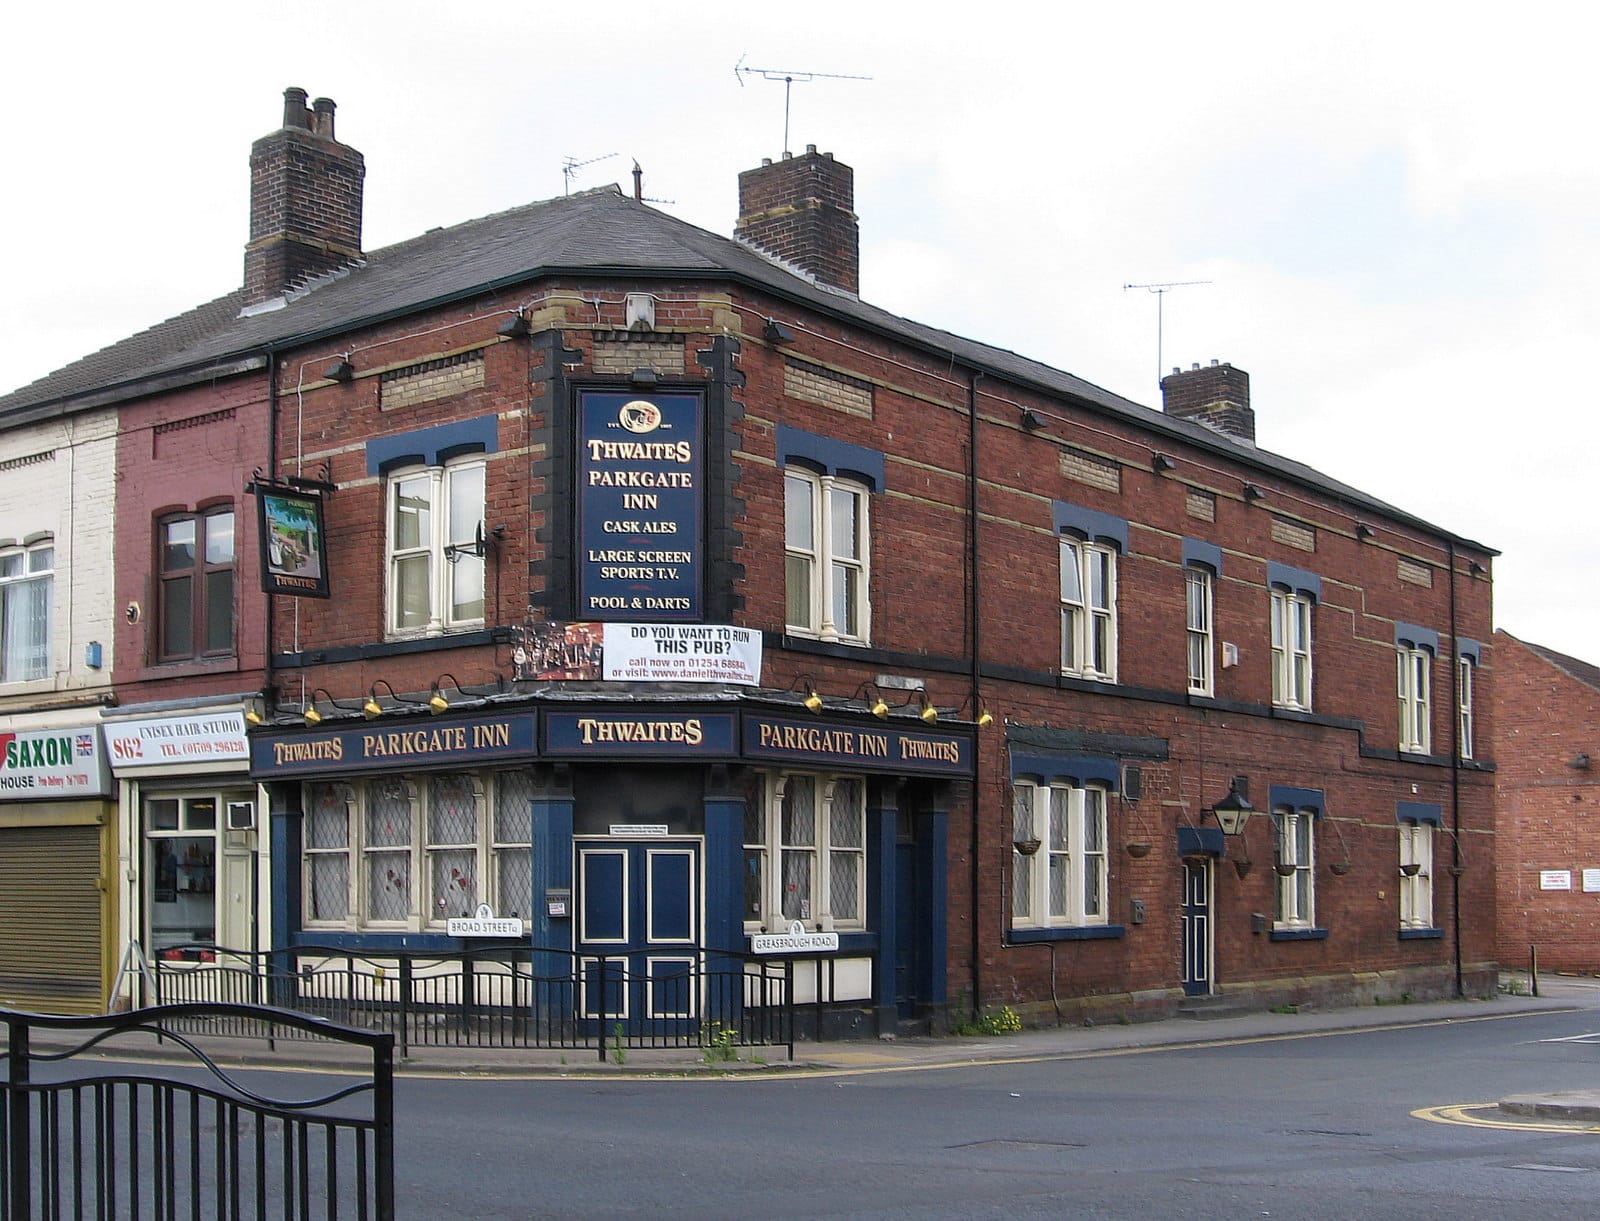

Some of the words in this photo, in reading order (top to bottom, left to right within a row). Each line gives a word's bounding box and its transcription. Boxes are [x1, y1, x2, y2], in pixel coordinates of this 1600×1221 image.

[588, 439, 692, 463] THWAITES
[589, 471, 692, 488] PARKGATE
[623, 494, 657, 510] INN
[603, 521, 640, 534] CASK
[643, 521, 677, 534] ALES
[588, 550, 635, 563] LARGE
[638, 551, 691, 564] SCREEN
[601, 567, 654, 579] SPORTS
[656, 568, 679, 579] T.V.
[274, 575, 317, 590] THWAITES
[589, 597, 628, 609] POOL
[631, 597, 643, 609] &
[646, 597, 690, 610] DARTS
[631, 627, 647, 638] DO
[651, 627, 674, 638] YOU
[678, 628, 713, 640] WANT
[717, 628, 730, 640] TO
[733, 630, 750, 643] RUN
[655, 640, 688, 654] THIS
[694, 641, 732, 655] PUB?
[629, 658, 646, 667] call
[650, 659, 670, 667] now
[688, 659, 718, 668] 01254
[612, 669, 622, 677] or
[625, 668, 648, 677] visit:
[139, 725, 174, 739] UNISEX
[175, 723, 200, 737] HAIR
[203, 720, 240, 734] STUDIO
[578, 719, 702, 745] THWAITES
[363, 727, 466, 758] PARKGATE
[472, 723, 510, 749] INN
[759, 723, 854, 755] PARKGATE
[858, 734, 889, 757] INN
[7, 737, 73, 769] SAXON
[113, 737, 143, 759] S62
[160, 744, 181, 757] TEL.
[273, 737, 343, 765] THWAITES
[899, 736, 959, 764] THWAITES
[0, 775, 35, 789] HOUSE
[452, 922, 480, 933] BROAD
[483, 922, 512, 933] STREET
[756, 938, 810, 949] GREASBROUGH
[812, 937, 831, 947] ROAD
